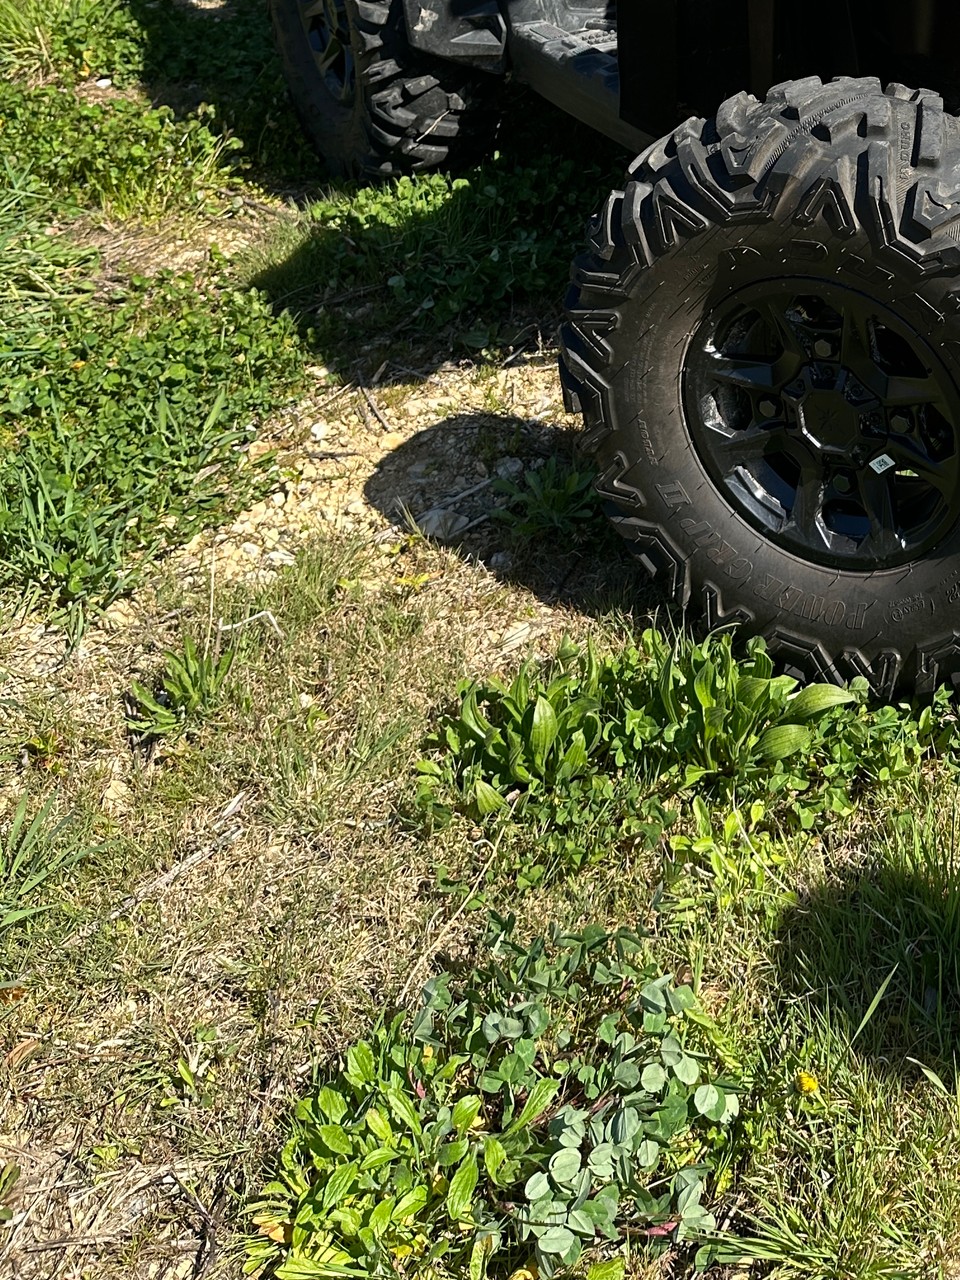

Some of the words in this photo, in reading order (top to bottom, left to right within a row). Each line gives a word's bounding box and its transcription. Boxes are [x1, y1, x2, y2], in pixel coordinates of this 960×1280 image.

[655, 479, 693, 508] II
[678, 517, 755, 580] GRIP
[753, 572, 870, 630] POWER
